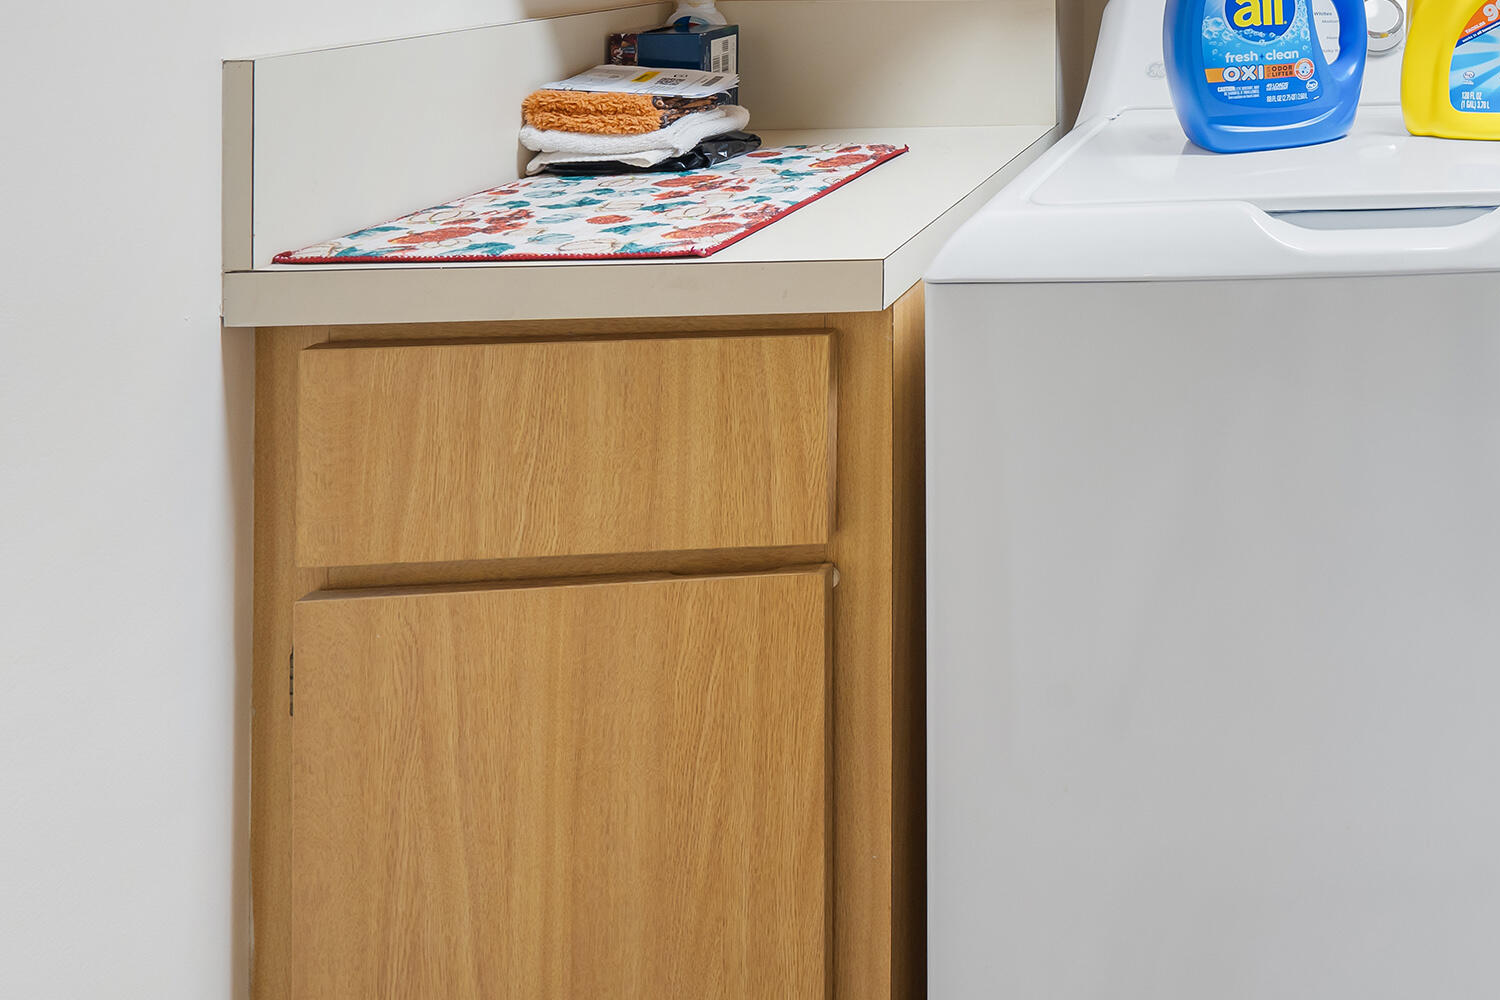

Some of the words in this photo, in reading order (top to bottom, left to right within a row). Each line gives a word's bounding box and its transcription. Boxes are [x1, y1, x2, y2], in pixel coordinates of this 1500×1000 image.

[1225, 51, 1259, 63] fresh
[1265, 49, 1299, 60] clean
[1223, 64, 1264, 82] OXI
